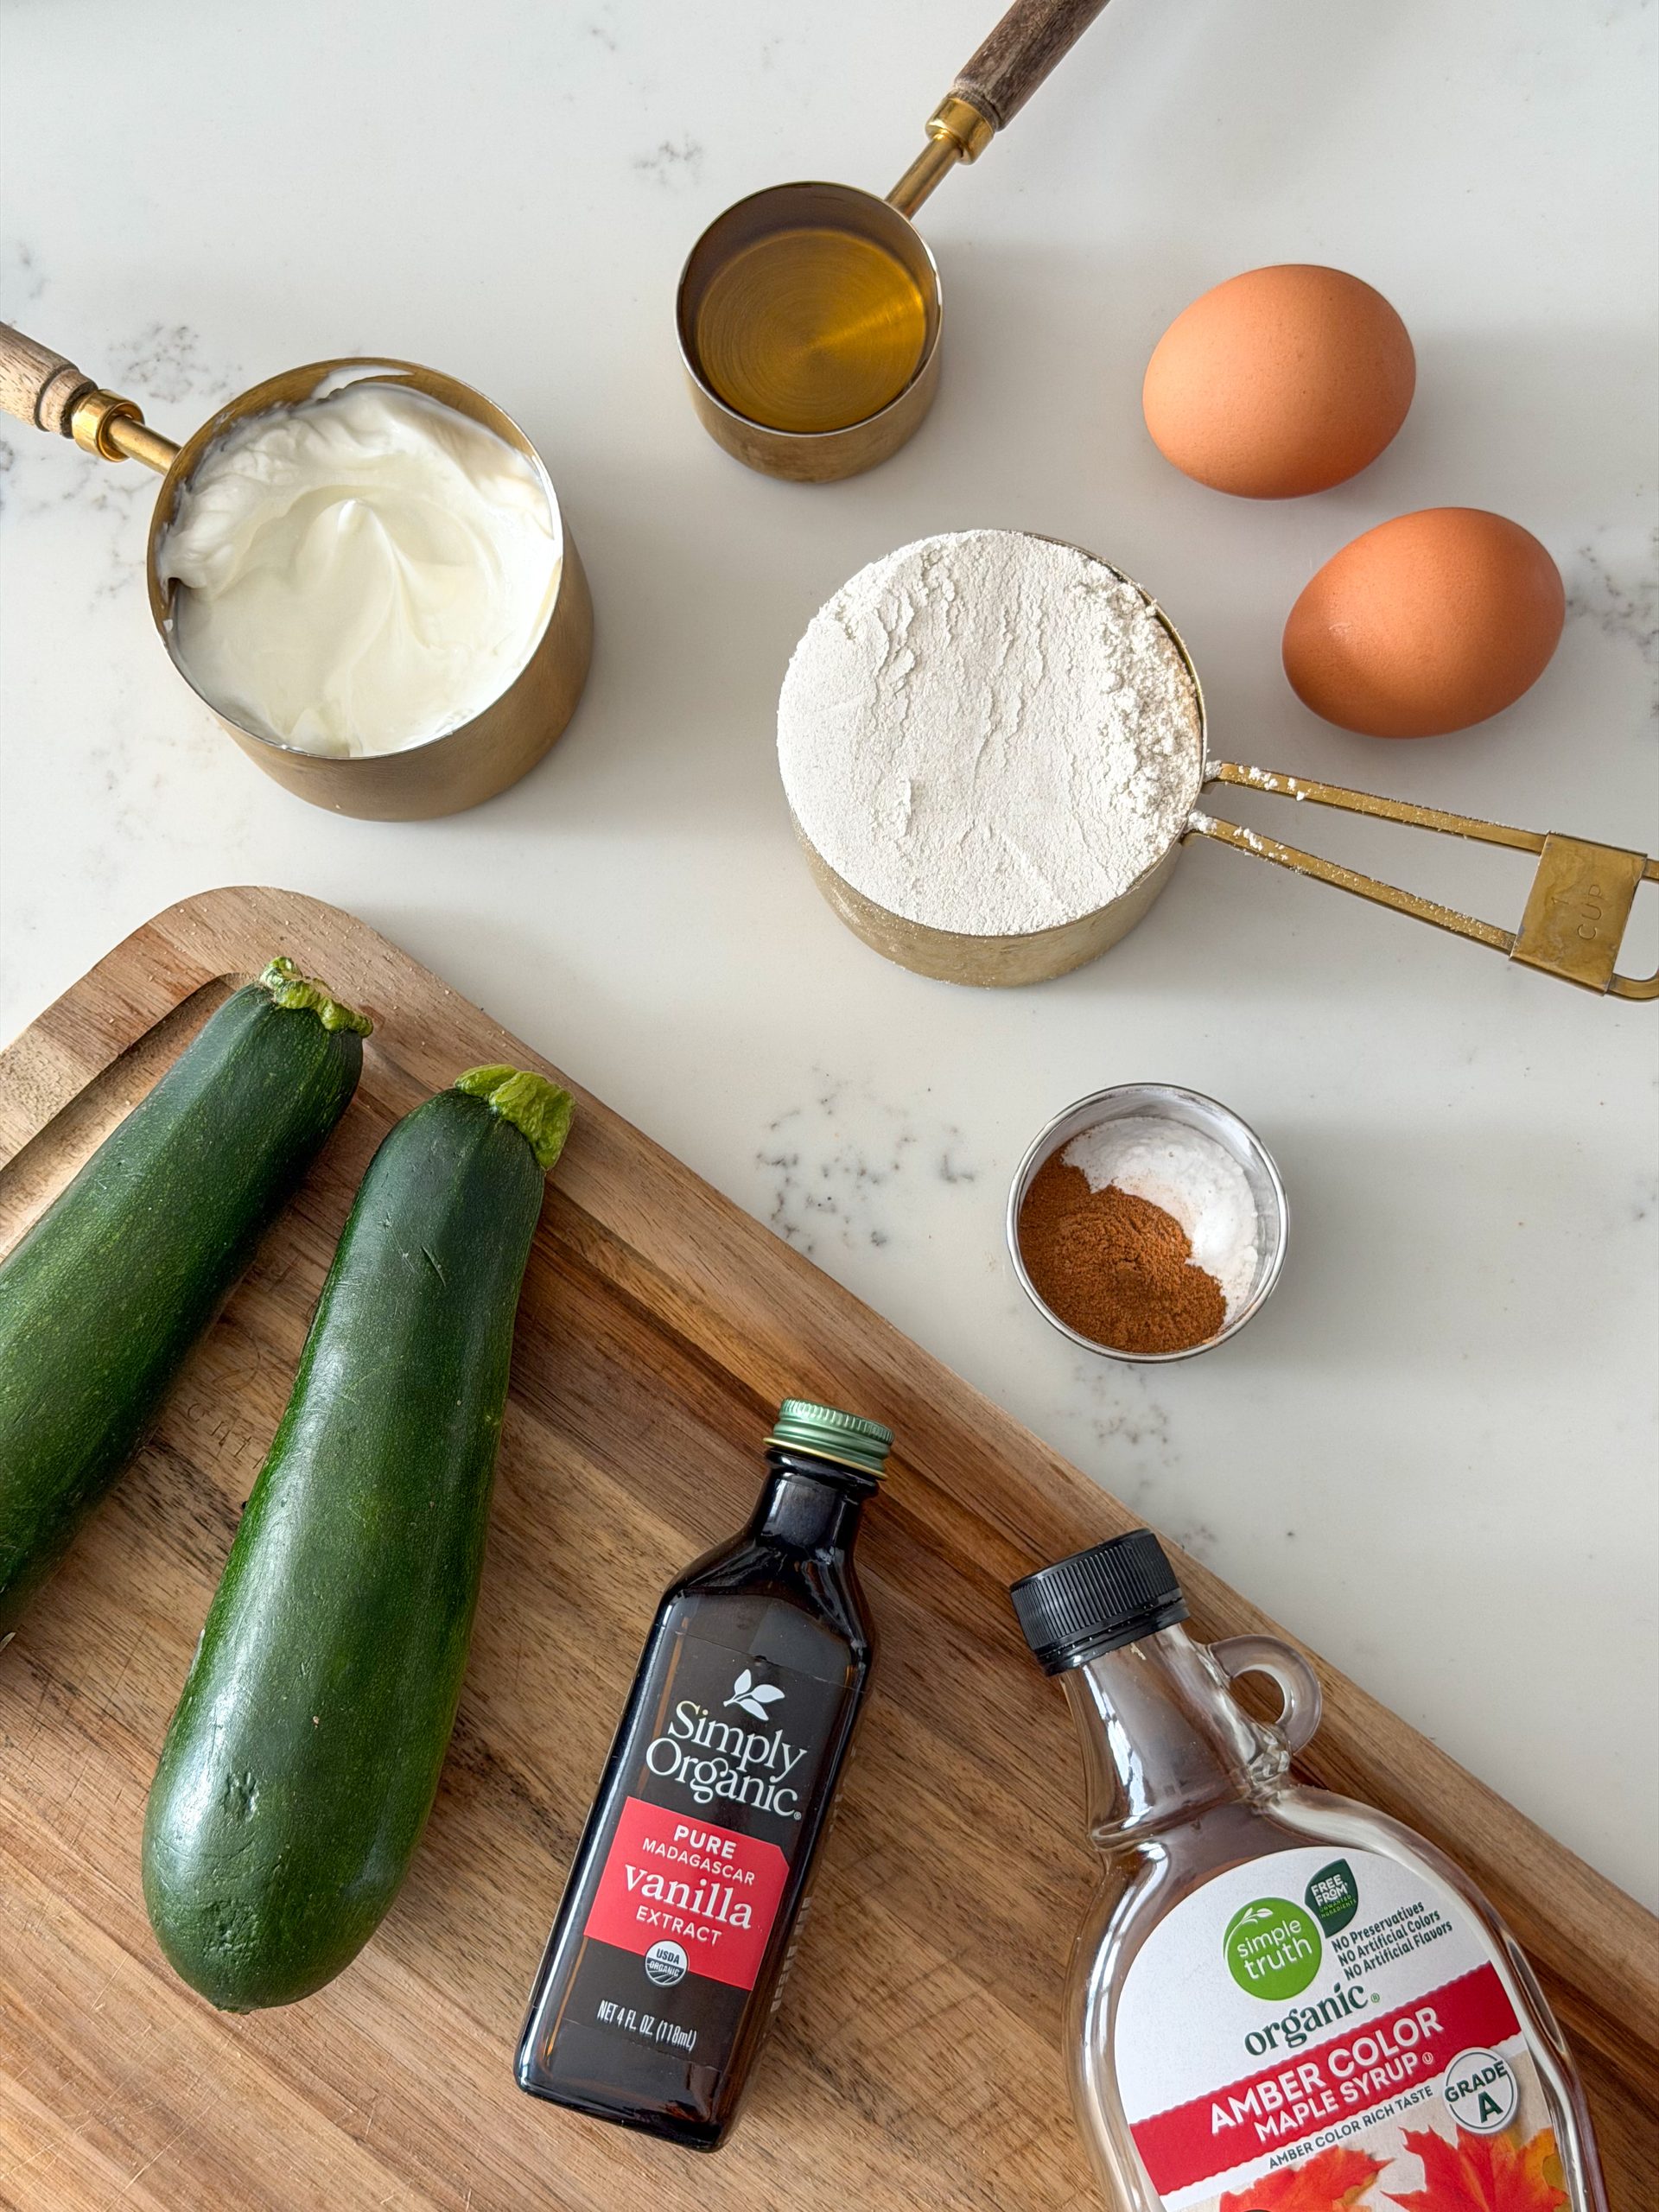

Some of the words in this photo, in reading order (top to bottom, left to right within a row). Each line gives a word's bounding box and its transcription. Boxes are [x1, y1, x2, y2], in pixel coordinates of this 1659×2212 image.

[1577, 884, 1606, 940] CUP
[668, 1700, 807, 1783] Simply
[642, 1838, 755, 1886] MADAGASCAR
[673, 1824, 737, 1859] PURE
[625, 1864, 753, 1929] vanilla
[1310, 1873, 1344, 1897] FREE
[635, 1905, 722, 1946] EXTRACT
[1236, 1919, 1302, 1958] simple
[1331, 1936, 1350, 1953] NO
[1350, 1901, 1425, 1944] Preservatives
[1337, 1949, 1356, 1967] NO
[1357, 1924, 1408, 1959] Artificial
[1407, 1910, 1440, 1934] Colors
[1343, 1963, 1363, 1980] NO
[1363, 1938, 1414, 1973] Artificial
[1413, 1920, 1452, 1948] Flavors
[649, 1960, 680, 1977] ORGANIC
[656, 1948, 680, 1965] USDA
[1243, 1937, 1313, 1980] truth
[597, 1999, 619, 2024] NET
[616, 2006, 626, 2027] 4
[655, 2019, 697, 2053] (118mL)
[1211, 2062, 1327, 2135] AMBER
[1327, 2006, 1445, 2077] COLOR
[1444, 2059, 1509, 2103] GRADE
[1254, 2089, 1339, 2144] MAPLE
[1339, 2051, 1418, 2103] SYRUP
[1477, 2090, 1504, 2124] A
[1269, 2141, 1314, 2169] AMBER
[1315, 2120, 1361, 2147] COLOR
[1362, 2103, 1395, 2126] RICH
[1395, 2084, 1433, 2111] TASTE
